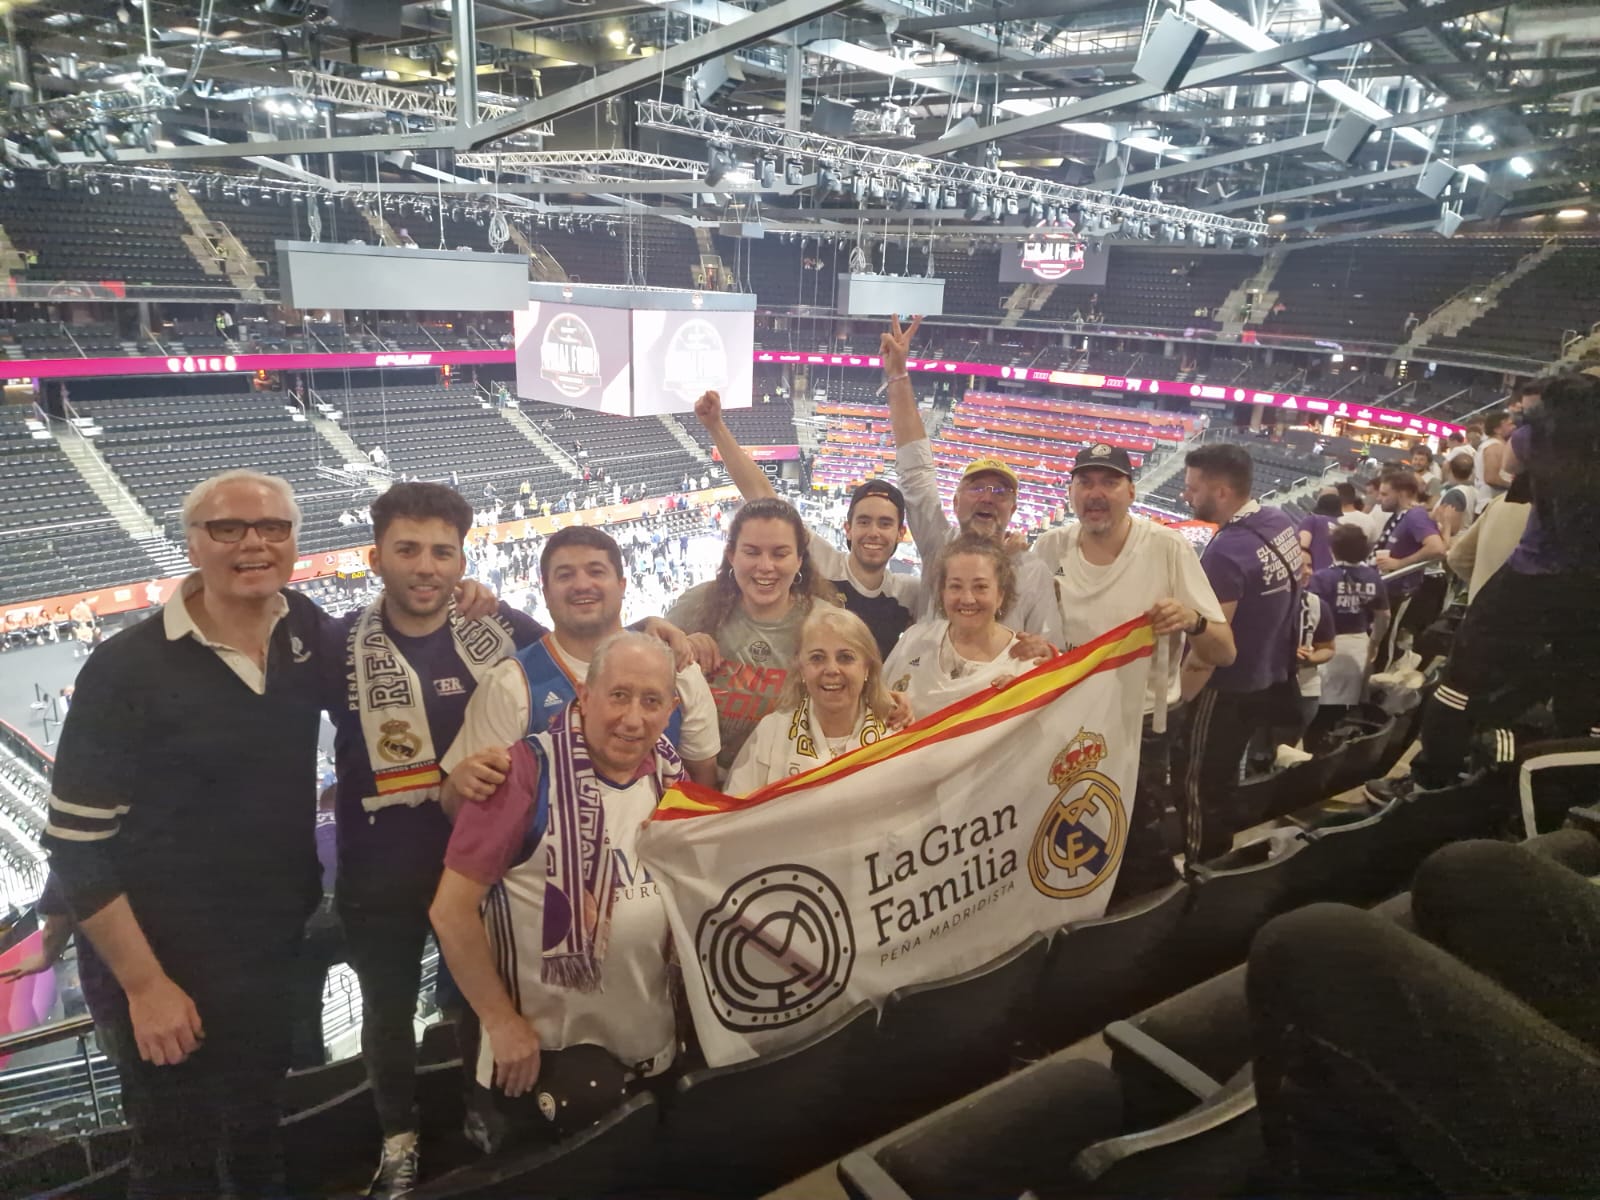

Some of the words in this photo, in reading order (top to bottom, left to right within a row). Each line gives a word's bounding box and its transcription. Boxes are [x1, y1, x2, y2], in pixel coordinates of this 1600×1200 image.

[712, 660, 788, 694] FINA
[870, 848, 1018, 947] Familia
[880, 937, 921, 967] PEÑA
[929, 881, 1015, 939] MADRIDISTA
